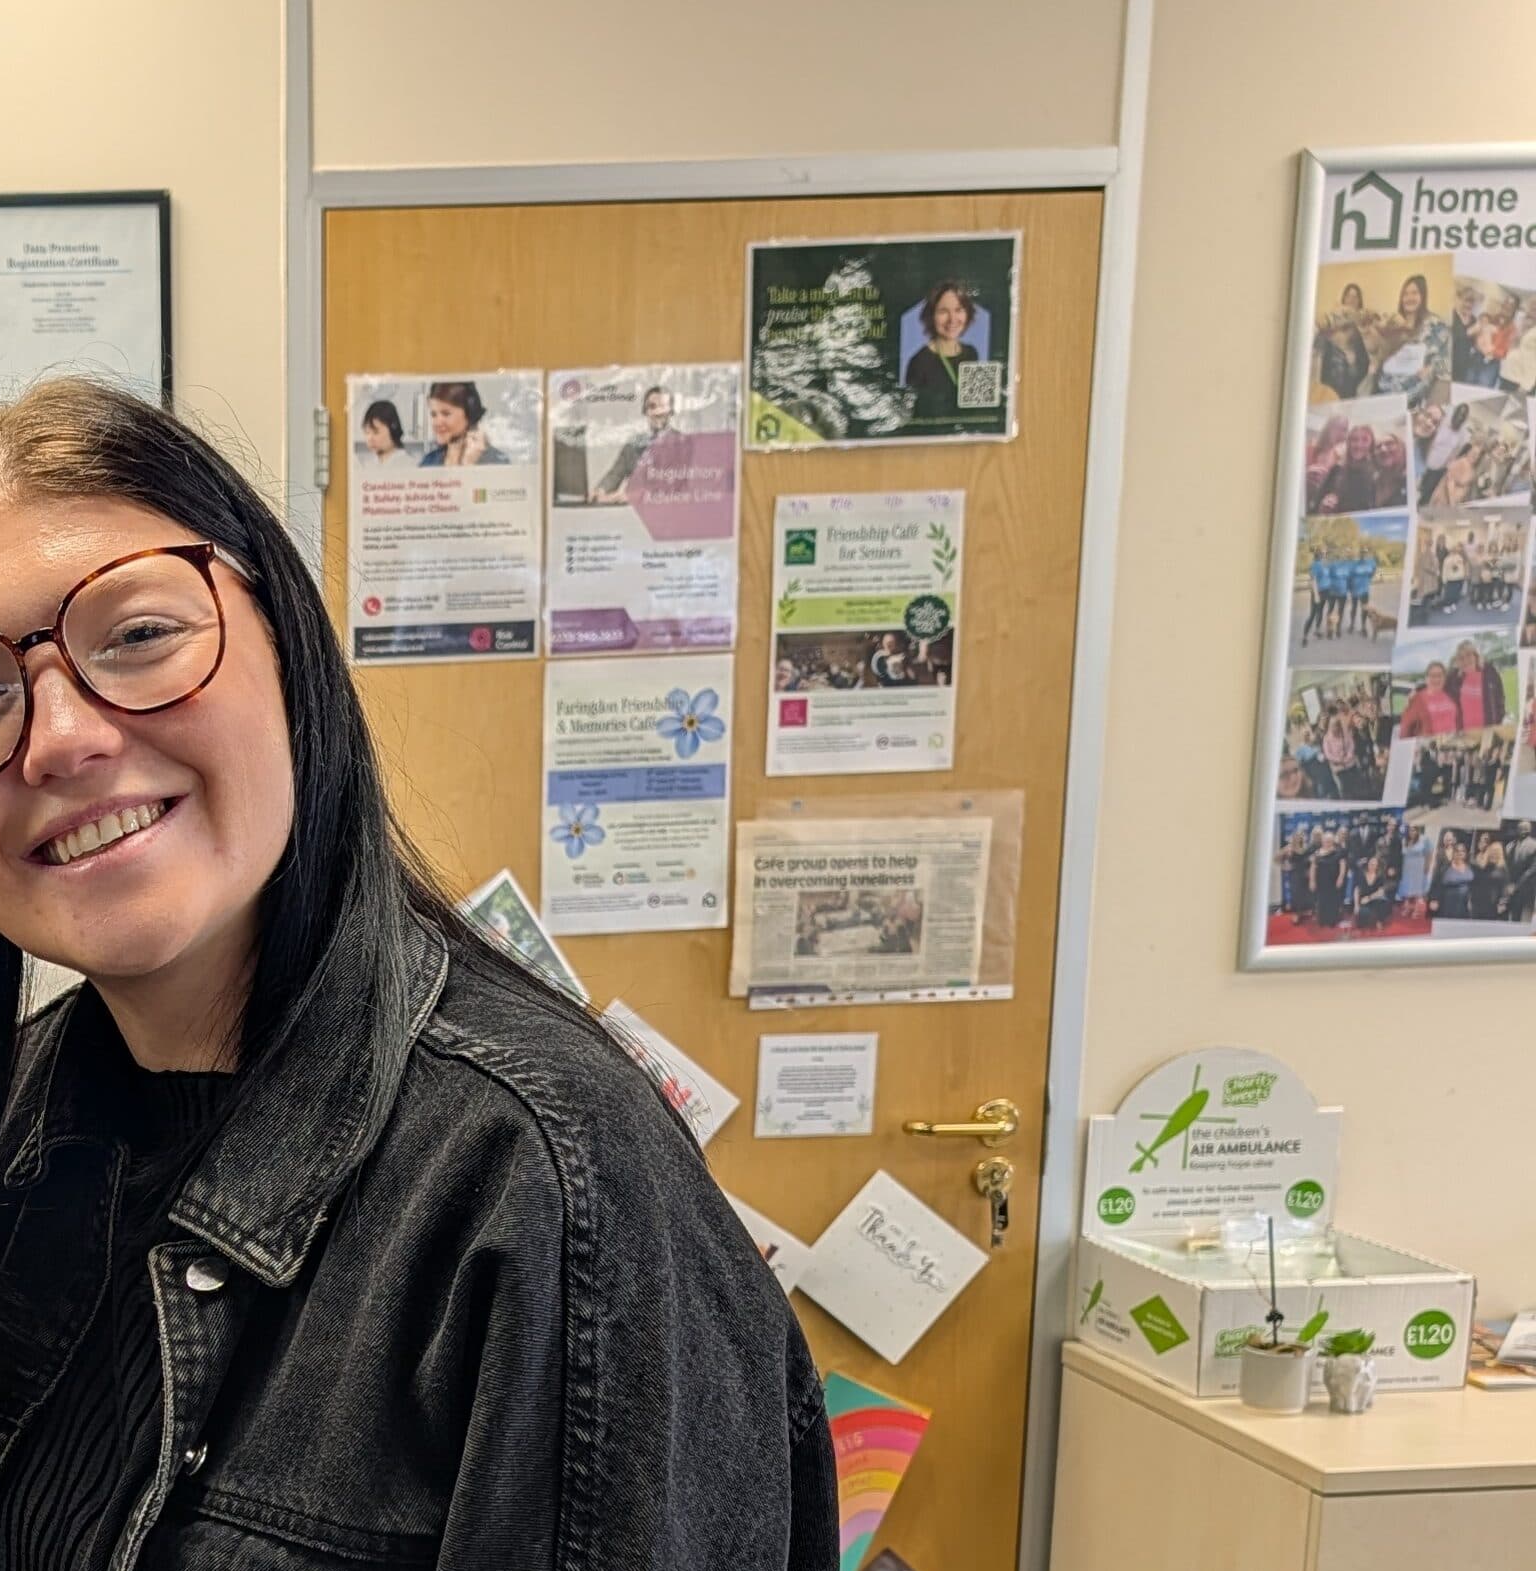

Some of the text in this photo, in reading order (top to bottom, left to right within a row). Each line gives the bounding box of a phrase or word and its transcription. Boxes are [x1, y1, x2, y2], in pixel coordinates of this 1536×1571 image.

[1413, 176, 1519, 213] home
[48, 242, 101, 253] Protection
[6, 255, 119, 270] Registration Certificate
[646, 464, 723, 481] Regulatory
[826, 523, 890, 543] Friendship
[838, 546, 902, 561] for Seniors
[556, 699, 618, 717] Faringdon
[556, 719, 566, 733] &
[569, 717, 626, 733] Memories
[753, 853, 919, 872] Cafe group opens to help
[769, 874, 848, 889] overcoming
[850, 873, 916, 886] loneliness
[1192, 1125, 1270, 1139] the children's
[1190, 1139, 1301, 1156] AIR AMBULANCE
[1099, 1197, 1133, 1216] £1.20
[1288, 1189, 1322, 1209] £1.20
[1407, 1323, 1454, 1347] £1.20
